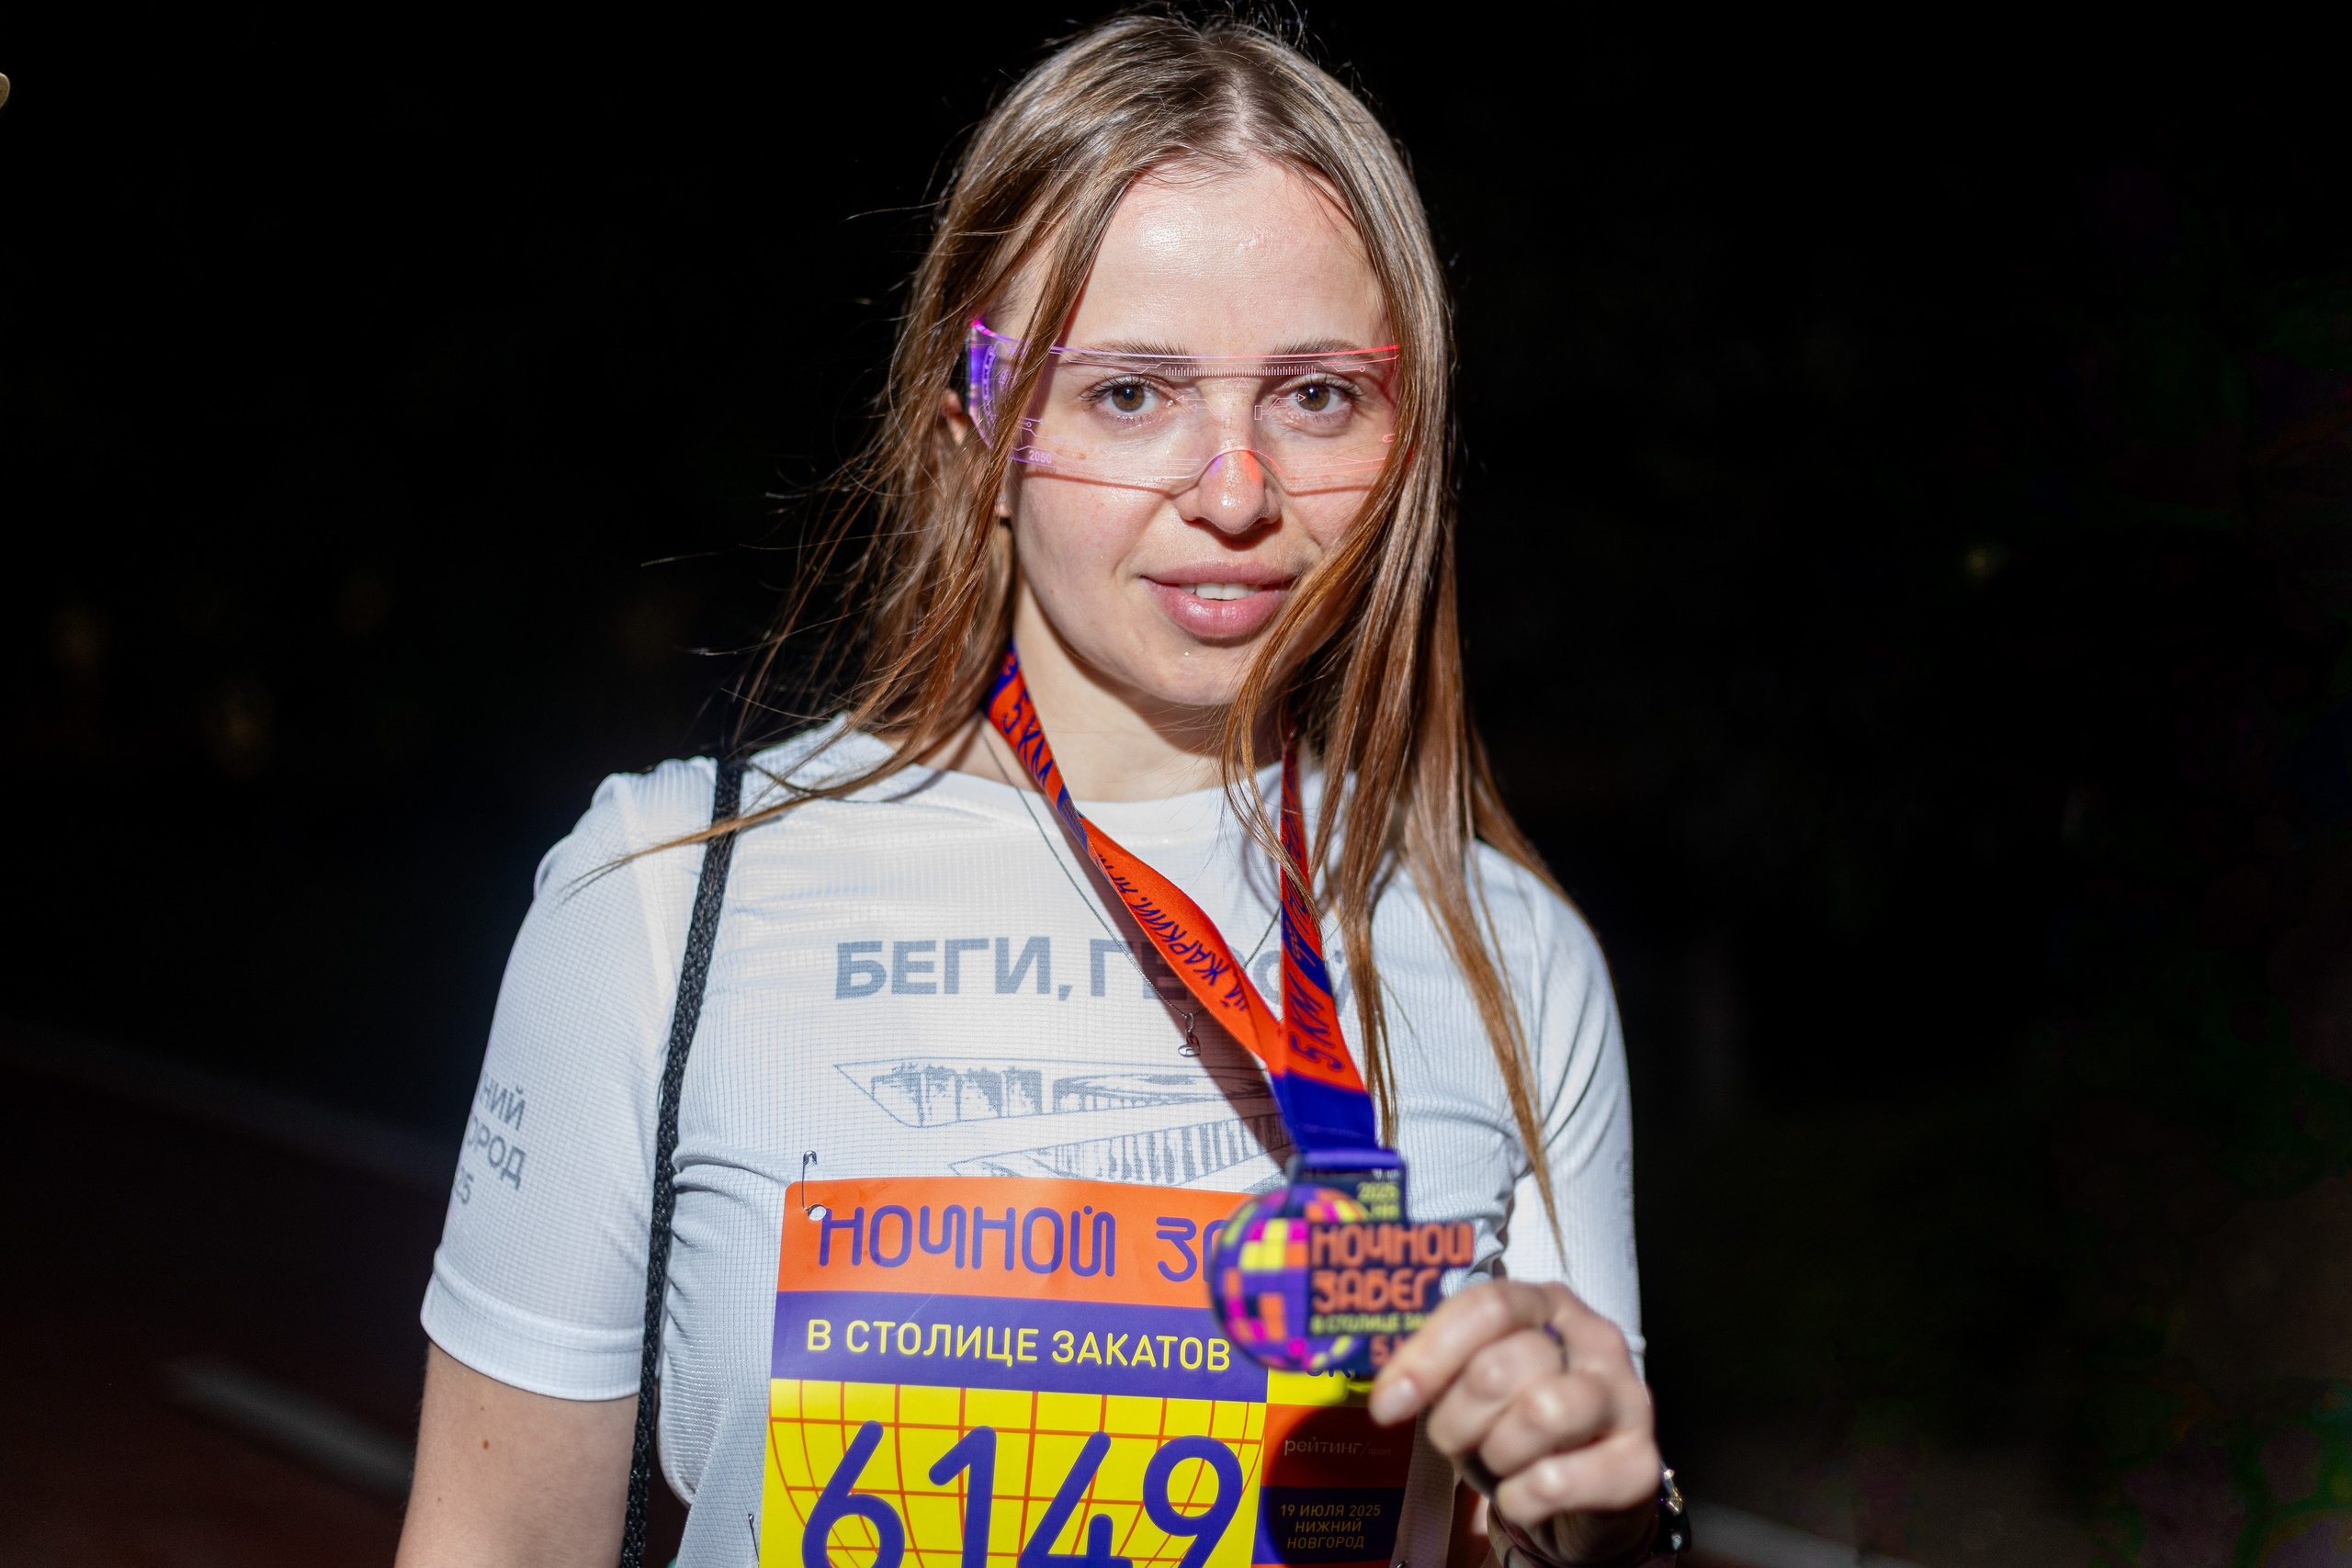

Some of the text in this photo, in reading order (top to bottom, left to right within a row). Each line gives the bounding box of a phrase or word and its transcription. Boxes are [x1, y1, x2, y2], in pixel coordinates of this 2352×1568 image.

[1029, 450, 1052, 464] 2050
[835, 936, 1072, 1001] БЕГИ,
[819, 1204, 1116, 1278] НОЧНОЙ
[1311, 1268, 1440, 1313] ЗАБЕГ
[807, 1318, 1231, 1371] В СТОЛИЦЕ ЗАКАТОВ
[801, 1420, 1244, 1568] 6149
[1281, 1504, 1381, 1517] 19 ИЮЛЯ 2025
[1286, 1535, 1364, 1550] НОВГОРОД
[1295, 1517, 1362, 1533] НИЖНИЙ
